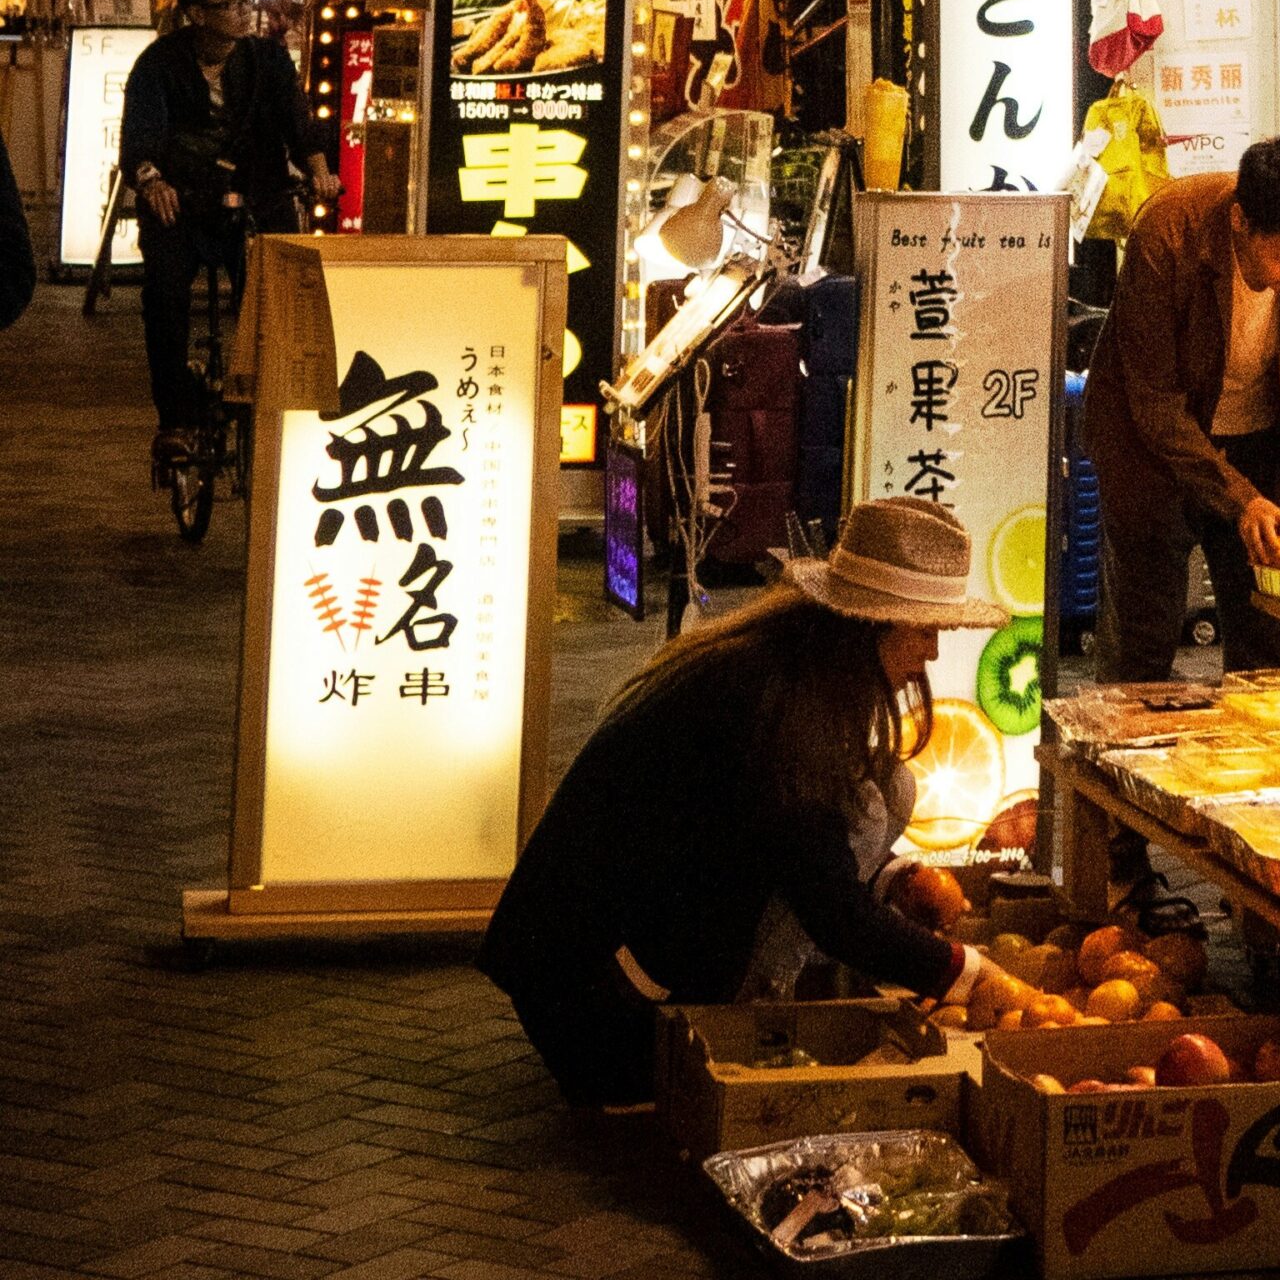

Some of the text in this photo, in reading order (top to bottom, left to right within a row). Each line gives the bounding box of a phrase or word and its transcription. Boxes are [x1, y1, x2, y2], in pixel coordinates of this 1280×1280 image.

[1160, 64, 1243, 92] 新秀丽
[458, 101, 582, 120] 1500円 900円
[1164, 97, 1241, 108] Samsonite
[1182, 135, 1226, 152] WPC
[890, 229, 928, 248] Best
[1000, 232, 1027, 248] tea
[1037, 229, 1052, 249] is
[904, 268, 959, 508] 萱果茶
[981, 368, 1040, 420] 2F
[311, 350, 466, 652] 無名
